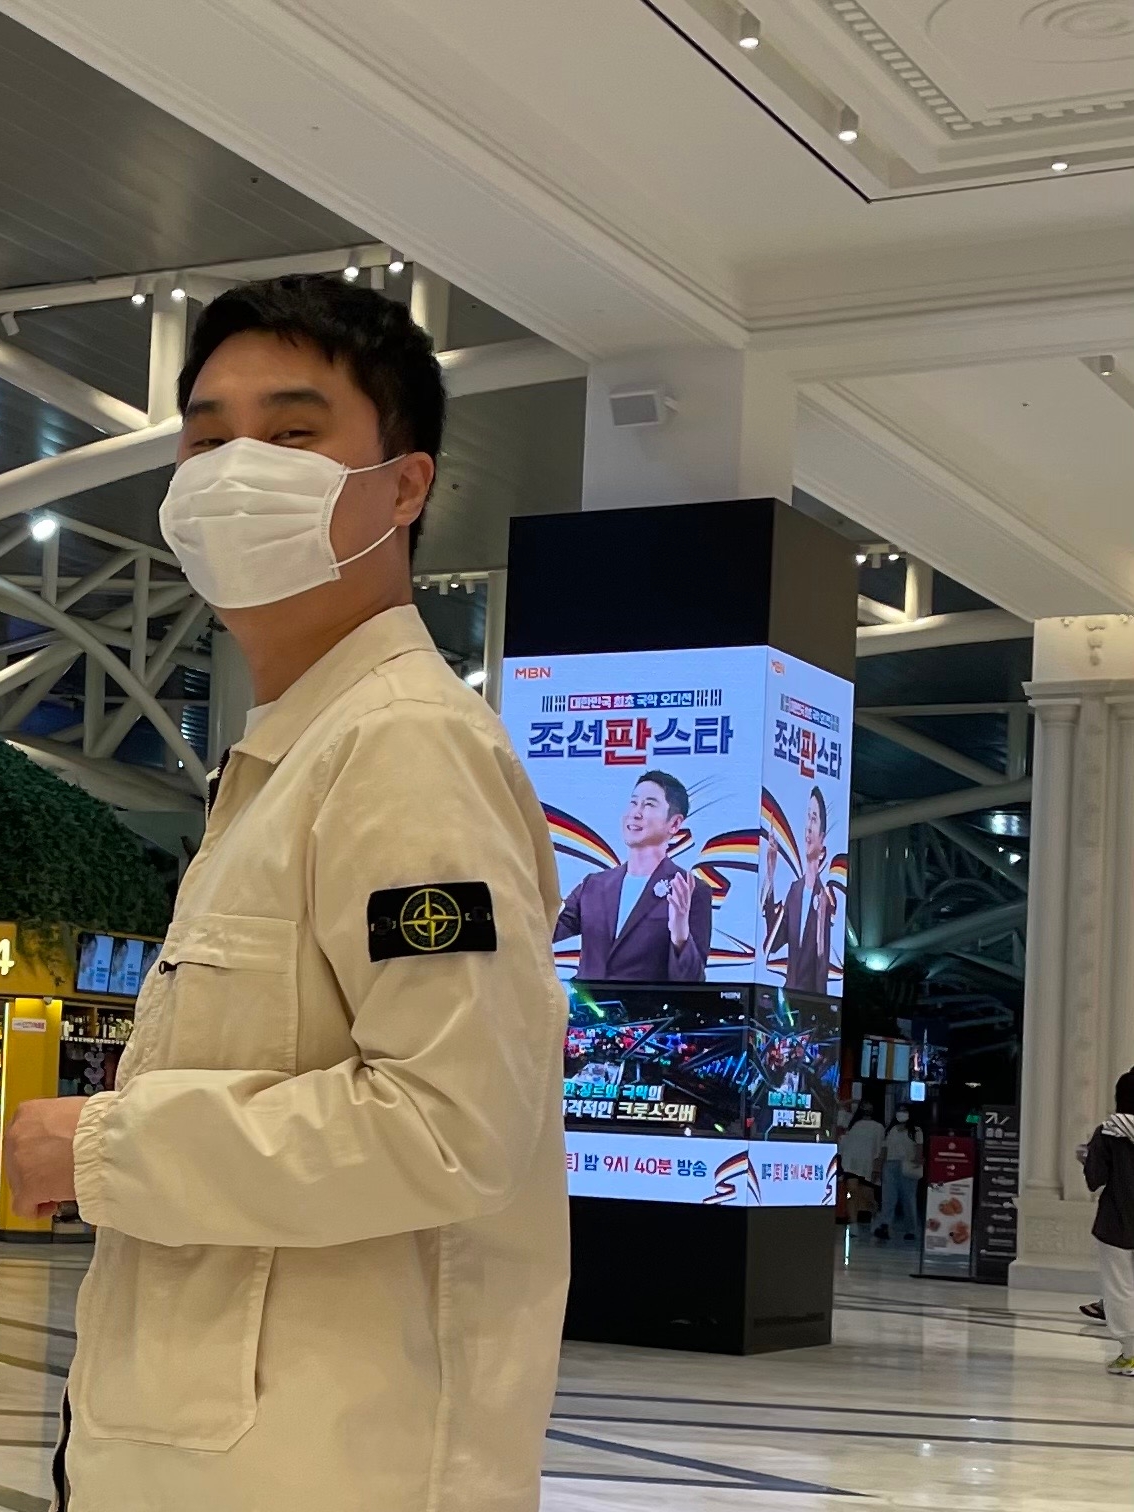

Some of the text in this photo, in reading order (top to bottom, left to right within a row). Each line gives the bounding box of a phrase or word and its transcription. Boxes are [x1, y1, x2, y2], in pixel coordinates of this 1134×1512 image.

[515, 667, 551, 680] MBN
[569, 695, 612, 709] 대한민국
[637, 692, 657, 707] 국악
[660, 691, 693, 707] 오디션
[527, 715, 734, 765] 조선판스타
[774, 719, 842, 780] 조선판스타
[579, 1082, 619, 1100] 장르와
[622, 1084, 664, 1101] 국악의
[617, 1101, 698, 1124] 크로스오버
[584, 1153, 600, 1172] 밤
[603, 1155, 629, 1173] 9시
[633, 1157, 672, 1176] 40분
[677, 1159, 708, 1178] 방송
